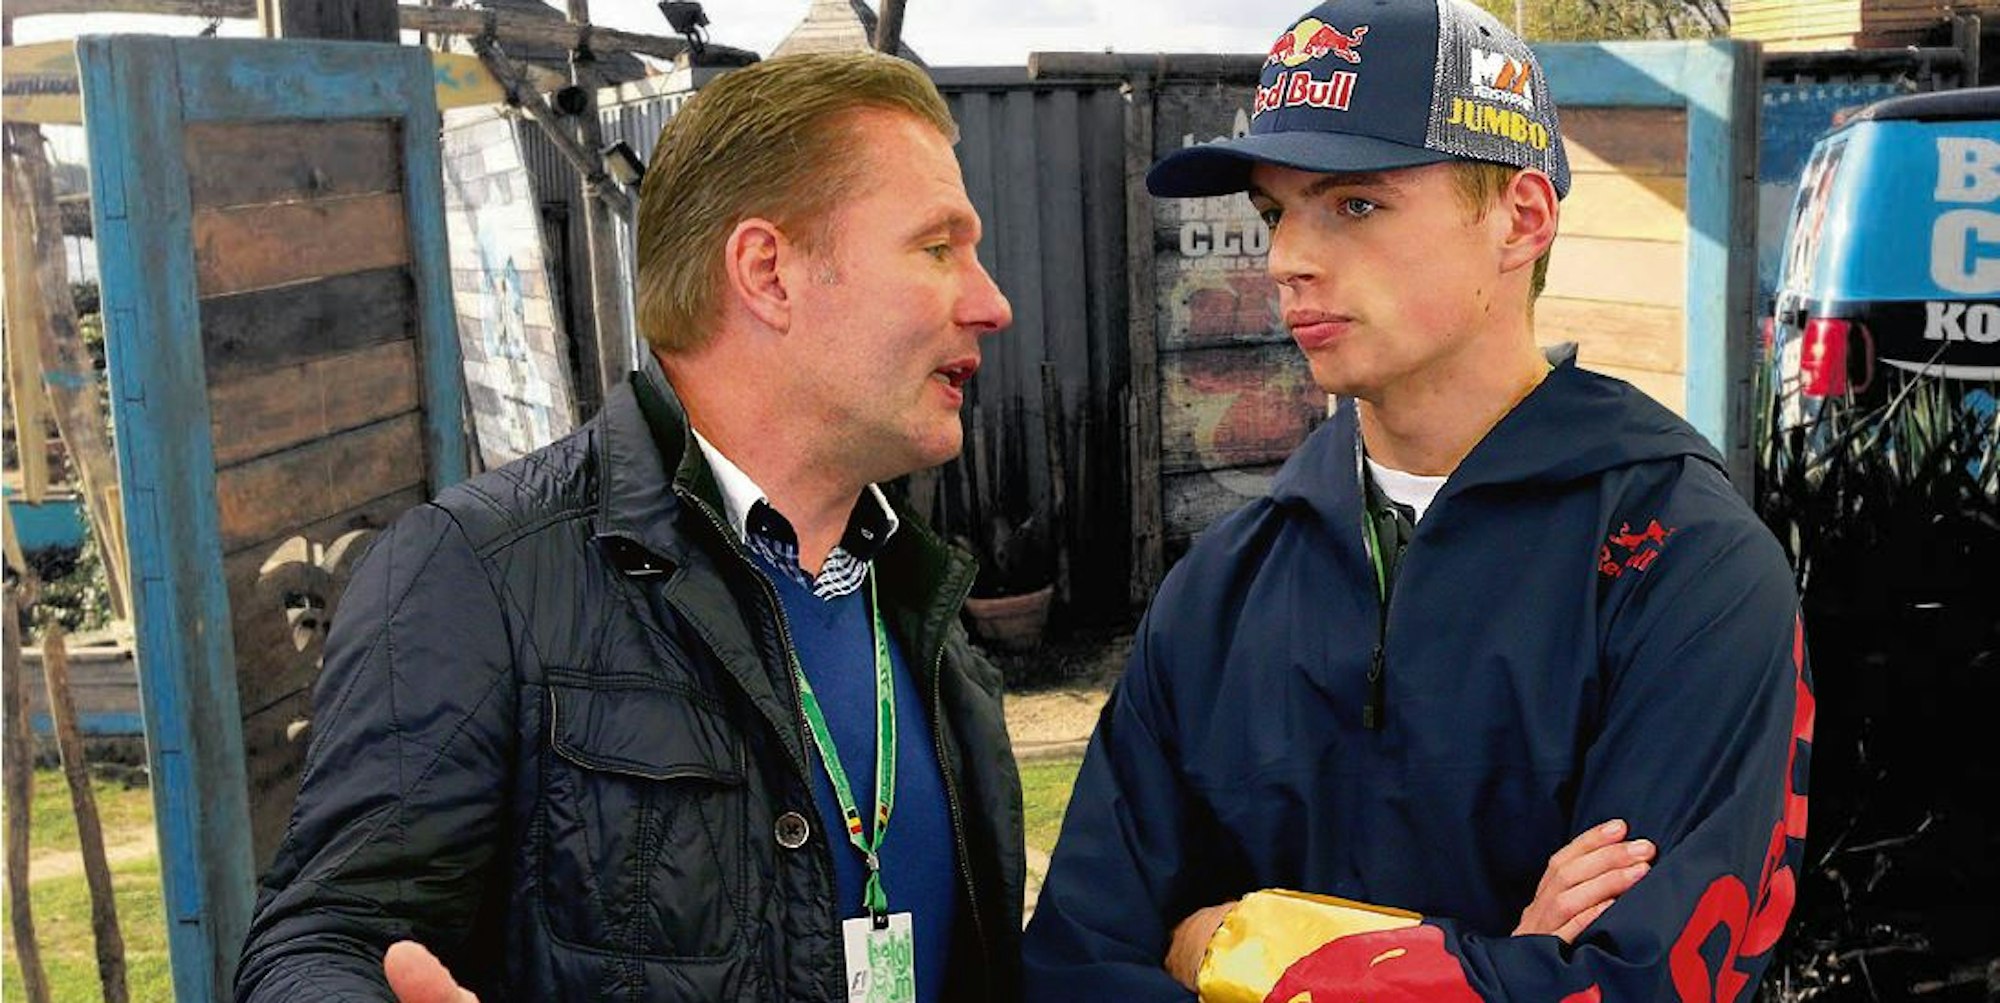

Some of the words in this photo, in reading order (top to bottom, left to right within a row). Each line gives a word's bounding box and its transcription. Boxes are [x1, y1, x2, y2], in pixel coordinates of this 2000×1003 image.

[1252, 71, 1287, 119] ed
[1285, 70, 1358, 111] Bull
[1447, 97, 1549, 151] JUMBO
